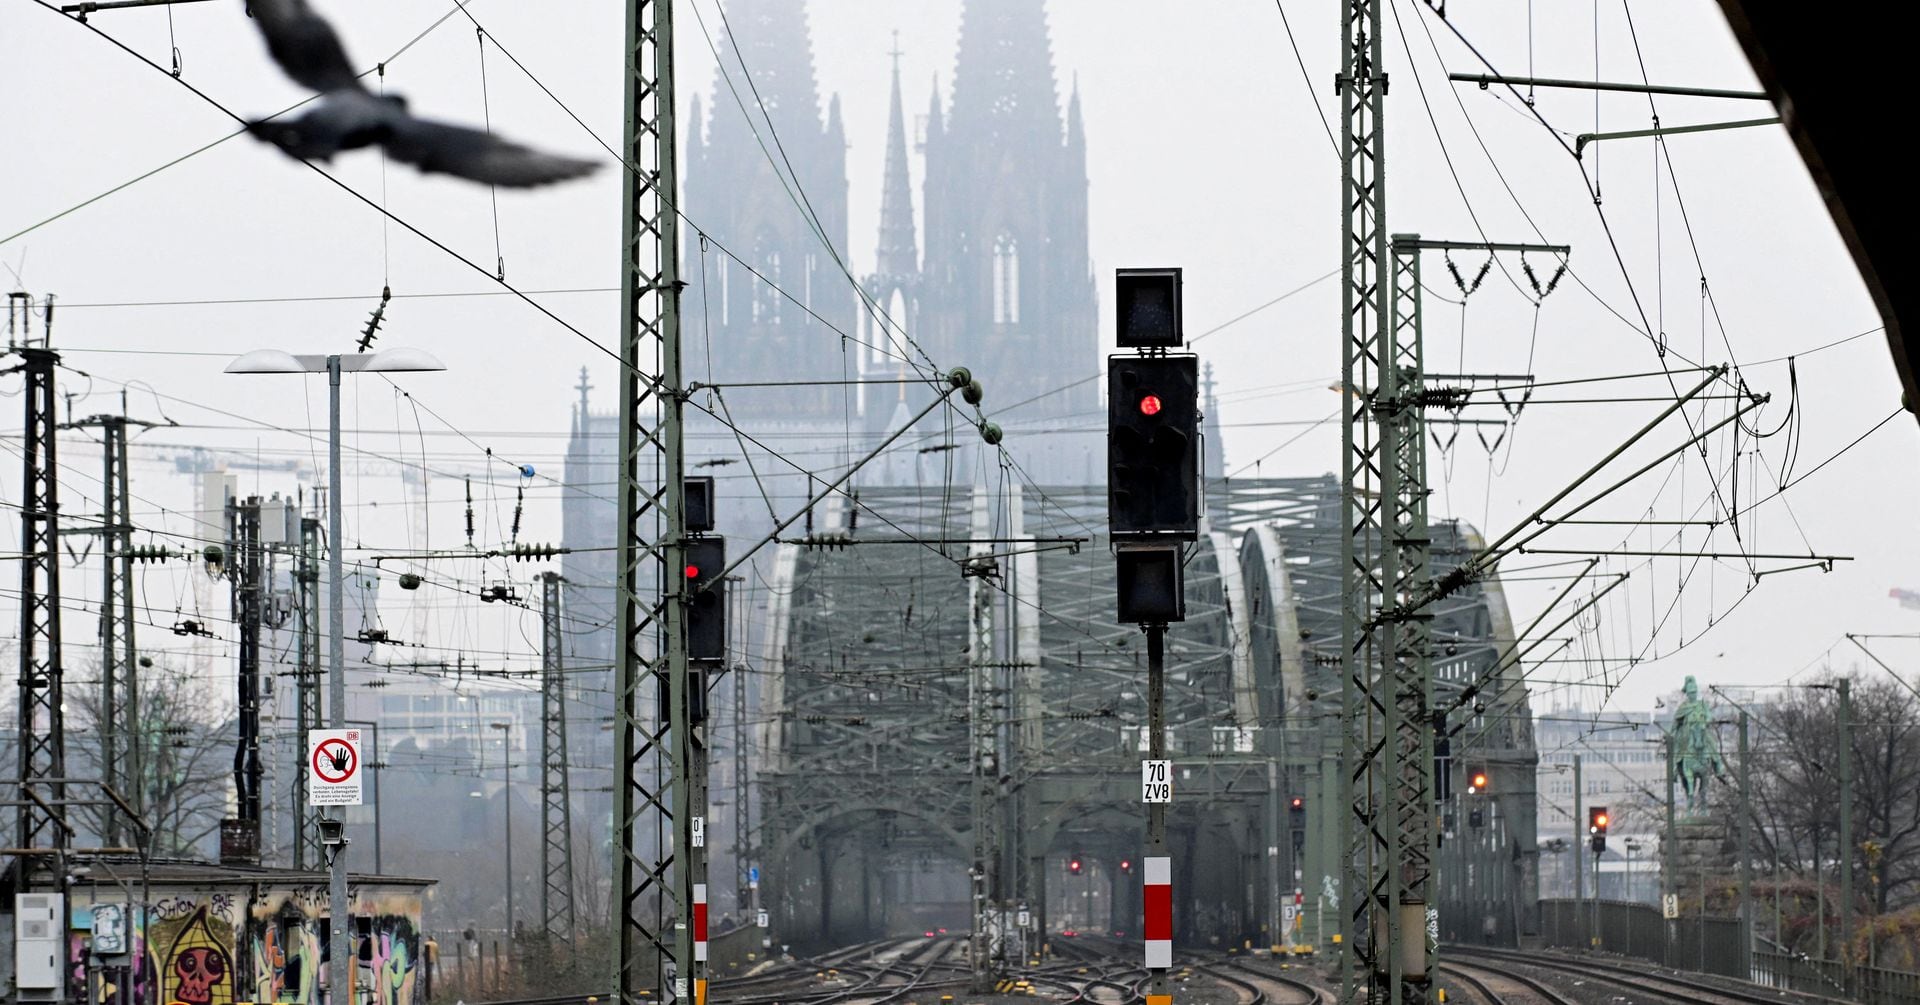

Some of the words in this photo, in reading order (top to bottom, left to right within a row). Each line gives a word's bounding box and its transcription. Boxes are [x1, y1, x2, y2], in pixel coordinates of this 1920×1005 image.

[1149, 764, 1164, 782] 70
[1145, 784, 1168, 799] ZV8
[694, 820, 699, 832] 0
[1287, 908, 1293, 918] 3
